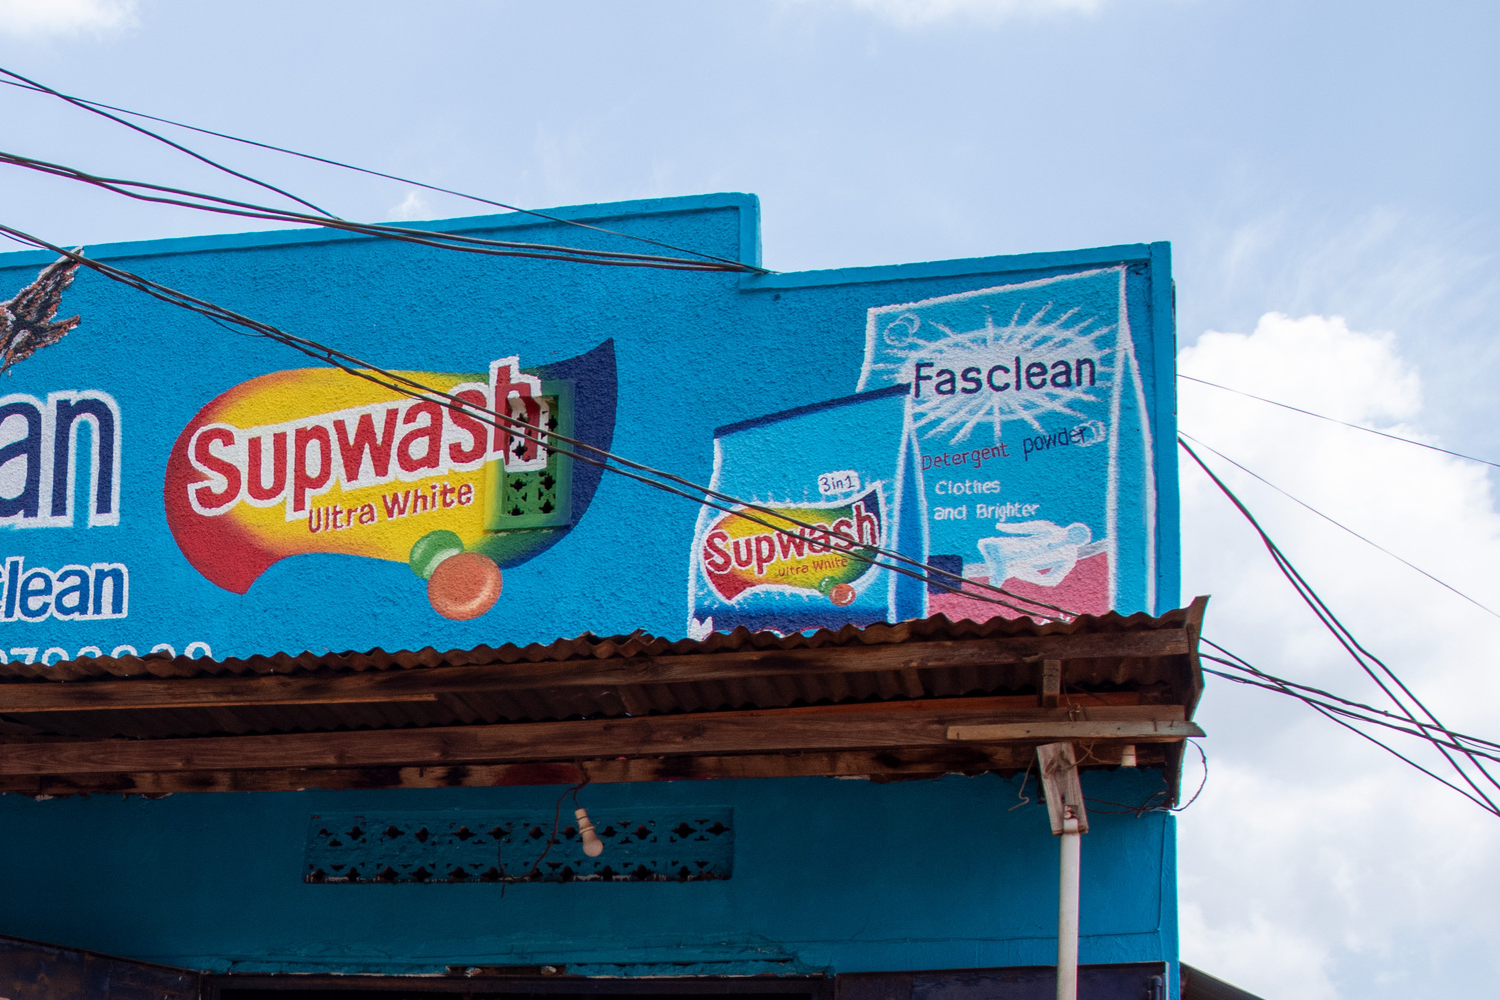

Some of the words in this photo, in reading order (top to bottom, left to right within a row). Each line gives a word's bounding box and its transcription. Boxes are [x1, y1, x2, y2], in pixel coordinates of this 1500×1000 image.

[913, 357, 1097, 399] Fasclean
[188, 355, 549, 520] Supwash
[920, 442, 1011, 472] Detergent
[1023, 427, 1088, 461] powder
[307, 503, 378, 535] Ultra
[381, 482, 476, 521] White
[935, 479, 1002, 496] Clothes
[934, 505, 968, 521] and
[976, 502, 1041, 522] Brighter
[702, 502, 881, 577] Supwash
[777, 561, 810, 578] Ultra
[812, 555, 849, 573] White
